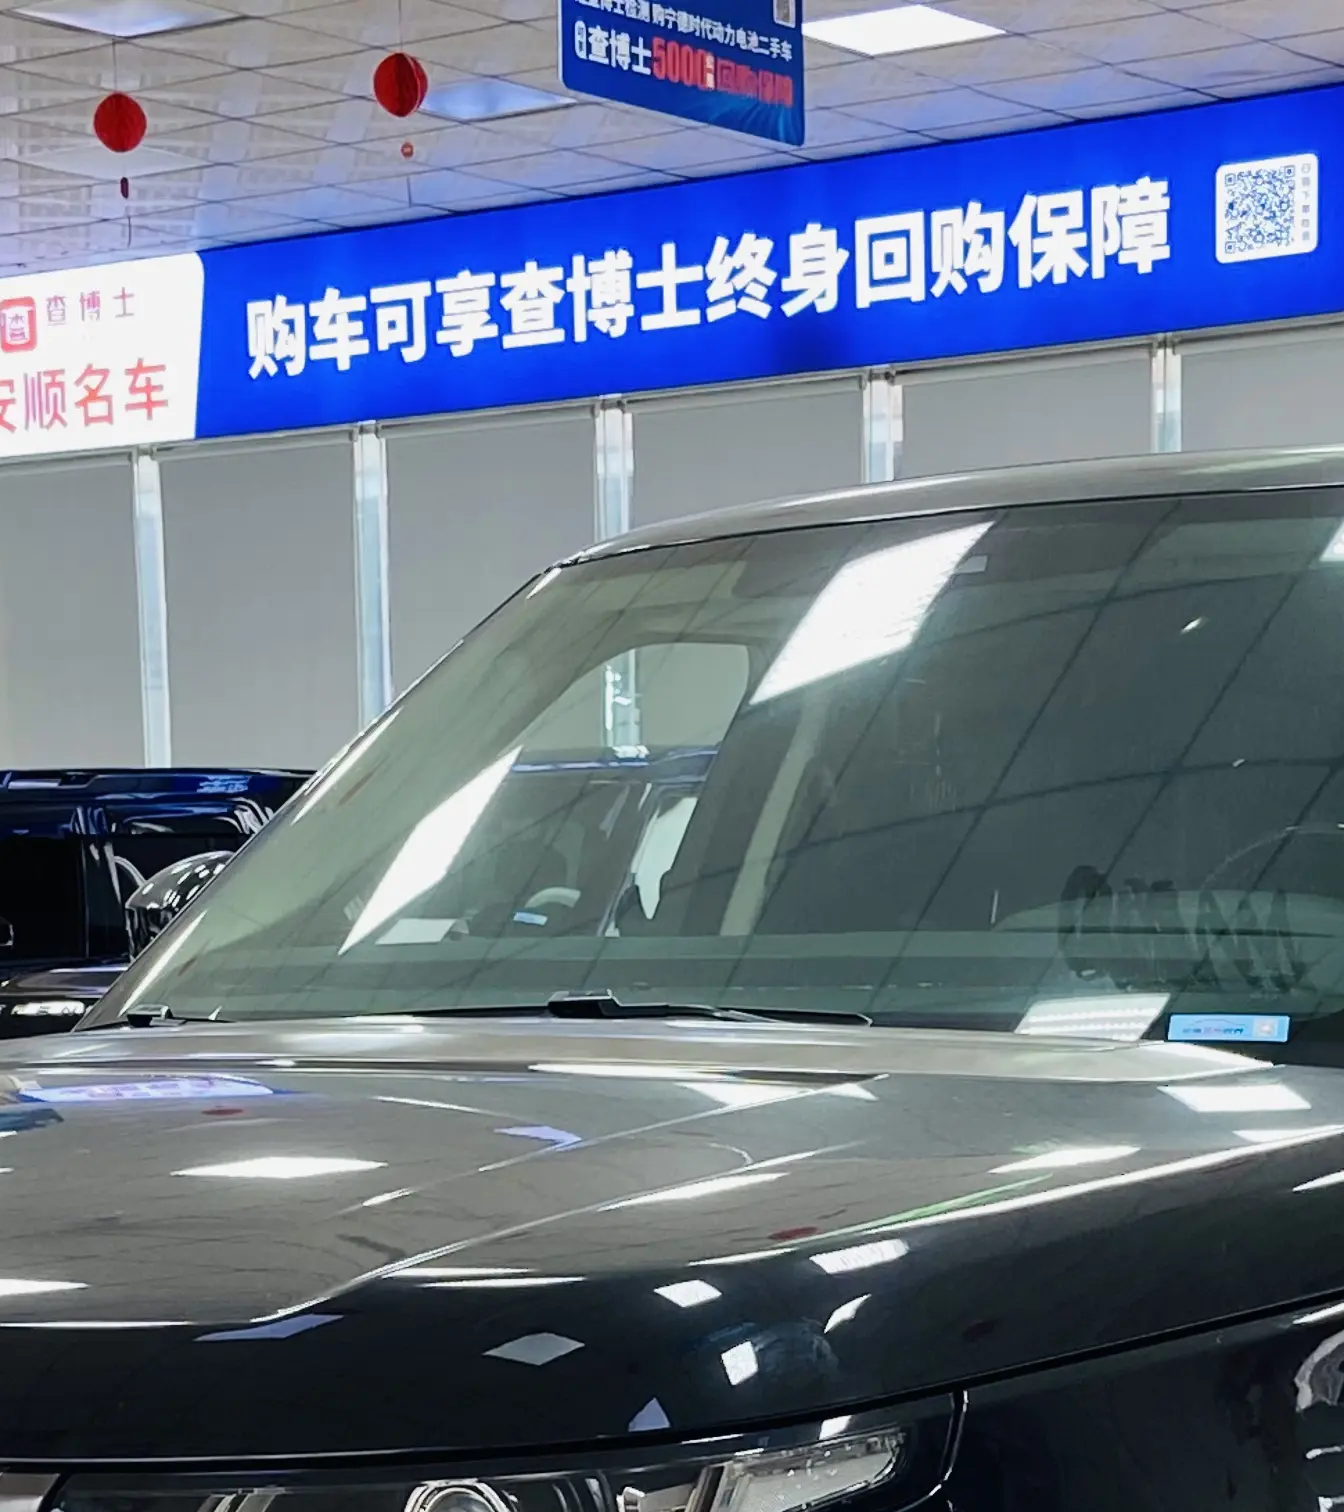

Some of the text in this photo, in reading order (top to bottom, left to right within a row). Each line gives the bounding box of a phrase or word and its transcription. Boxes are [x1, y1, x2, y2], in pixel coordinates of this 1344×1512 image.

[45, 286, 135, 326] 查博士
[246, 177, 1171, 380] 购车可享查博士终身回购保障
